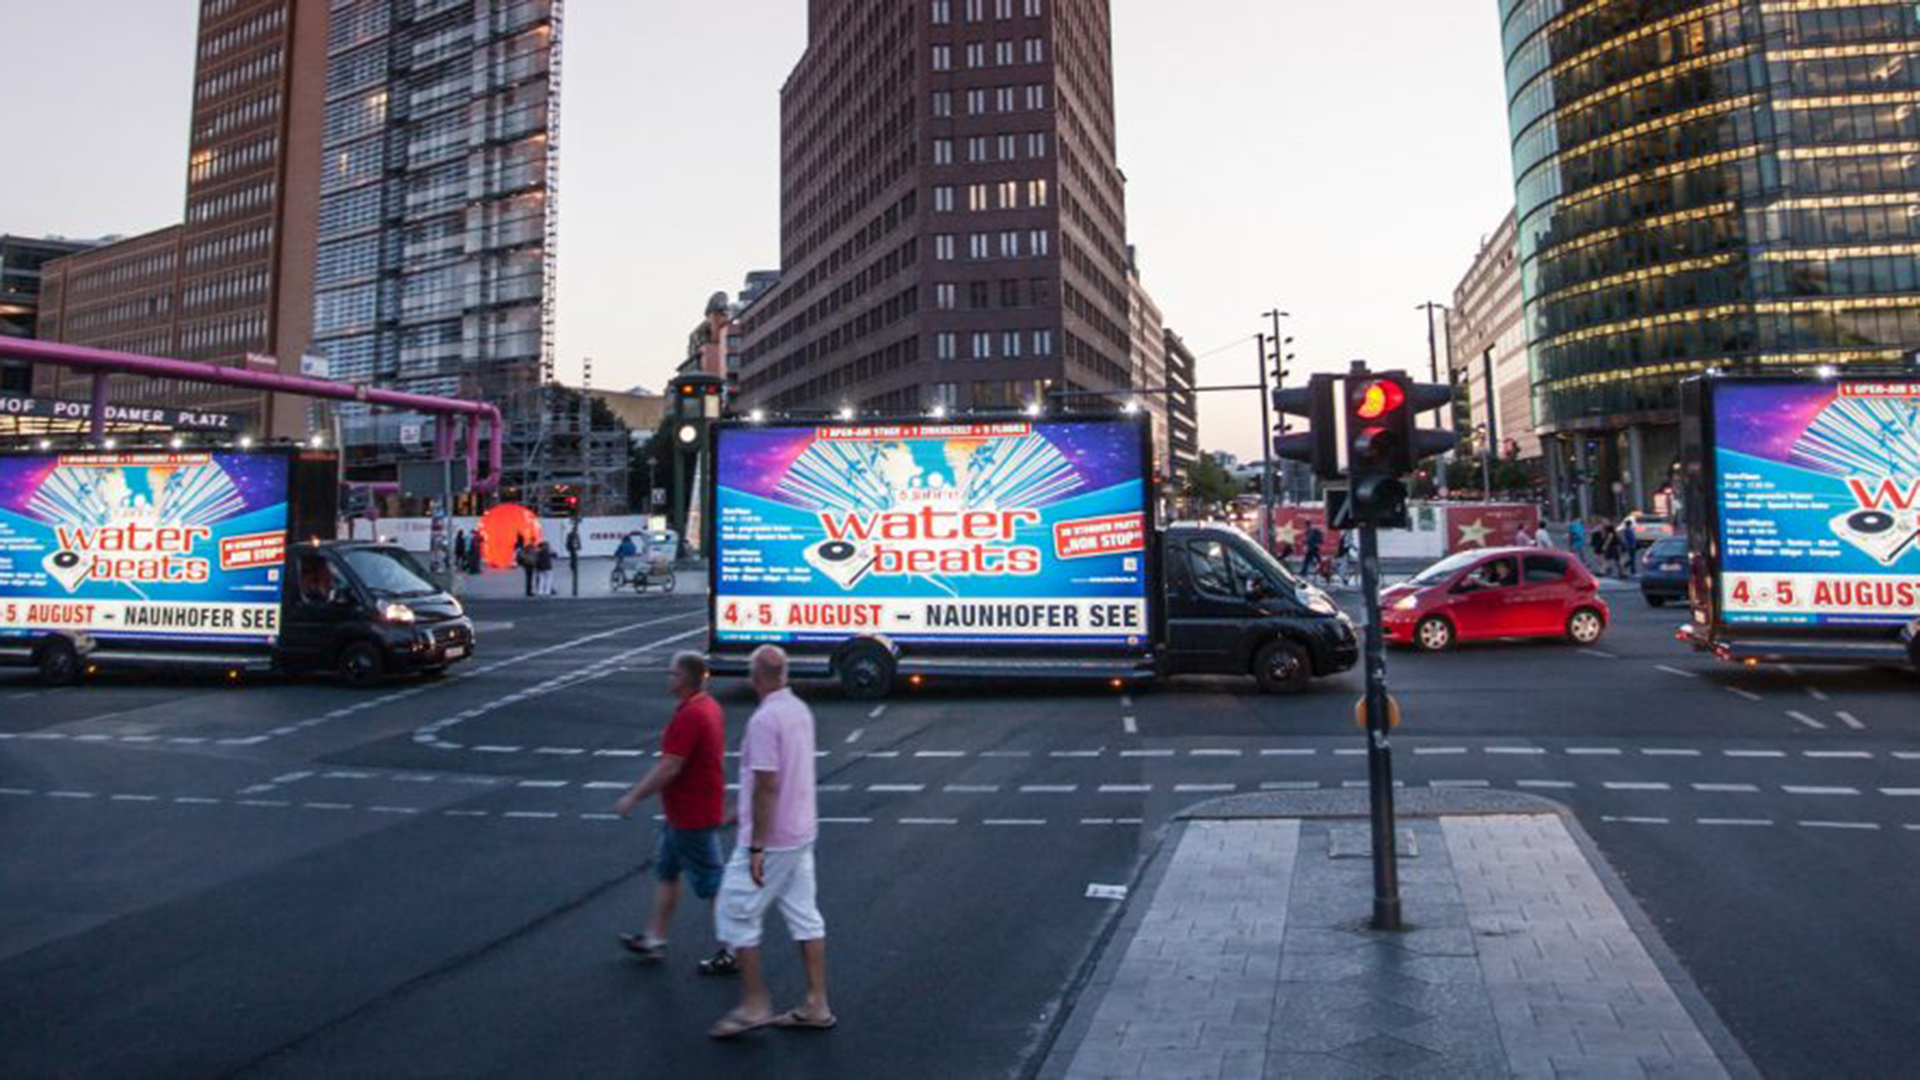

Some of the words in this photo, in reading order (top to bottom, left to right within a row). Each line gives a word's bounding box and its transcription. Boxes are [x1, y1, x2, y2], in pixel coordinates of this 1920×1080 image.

[54, 401, 164, 422] POTDAMER
[179, 411, 229, 427] PLATZ
[820, 506, 1038, 540] water
[57, 522, 210, 552] water
[90, 554, 209, 580] beats
[872, 544, 1039, 573] beats
[1813, 581, 1920, 607] AUGUS
[26, 604, 95, 623] AUGUST
[124, 605, 235, 628] NAUNHOFER
[241, 608, 276, 629] SEE
[787, 604, 883, 626] AUGUST
[926, 604, 1079, 627] NAUNHOFER
[1089, 604, 1139, 628] SEE
